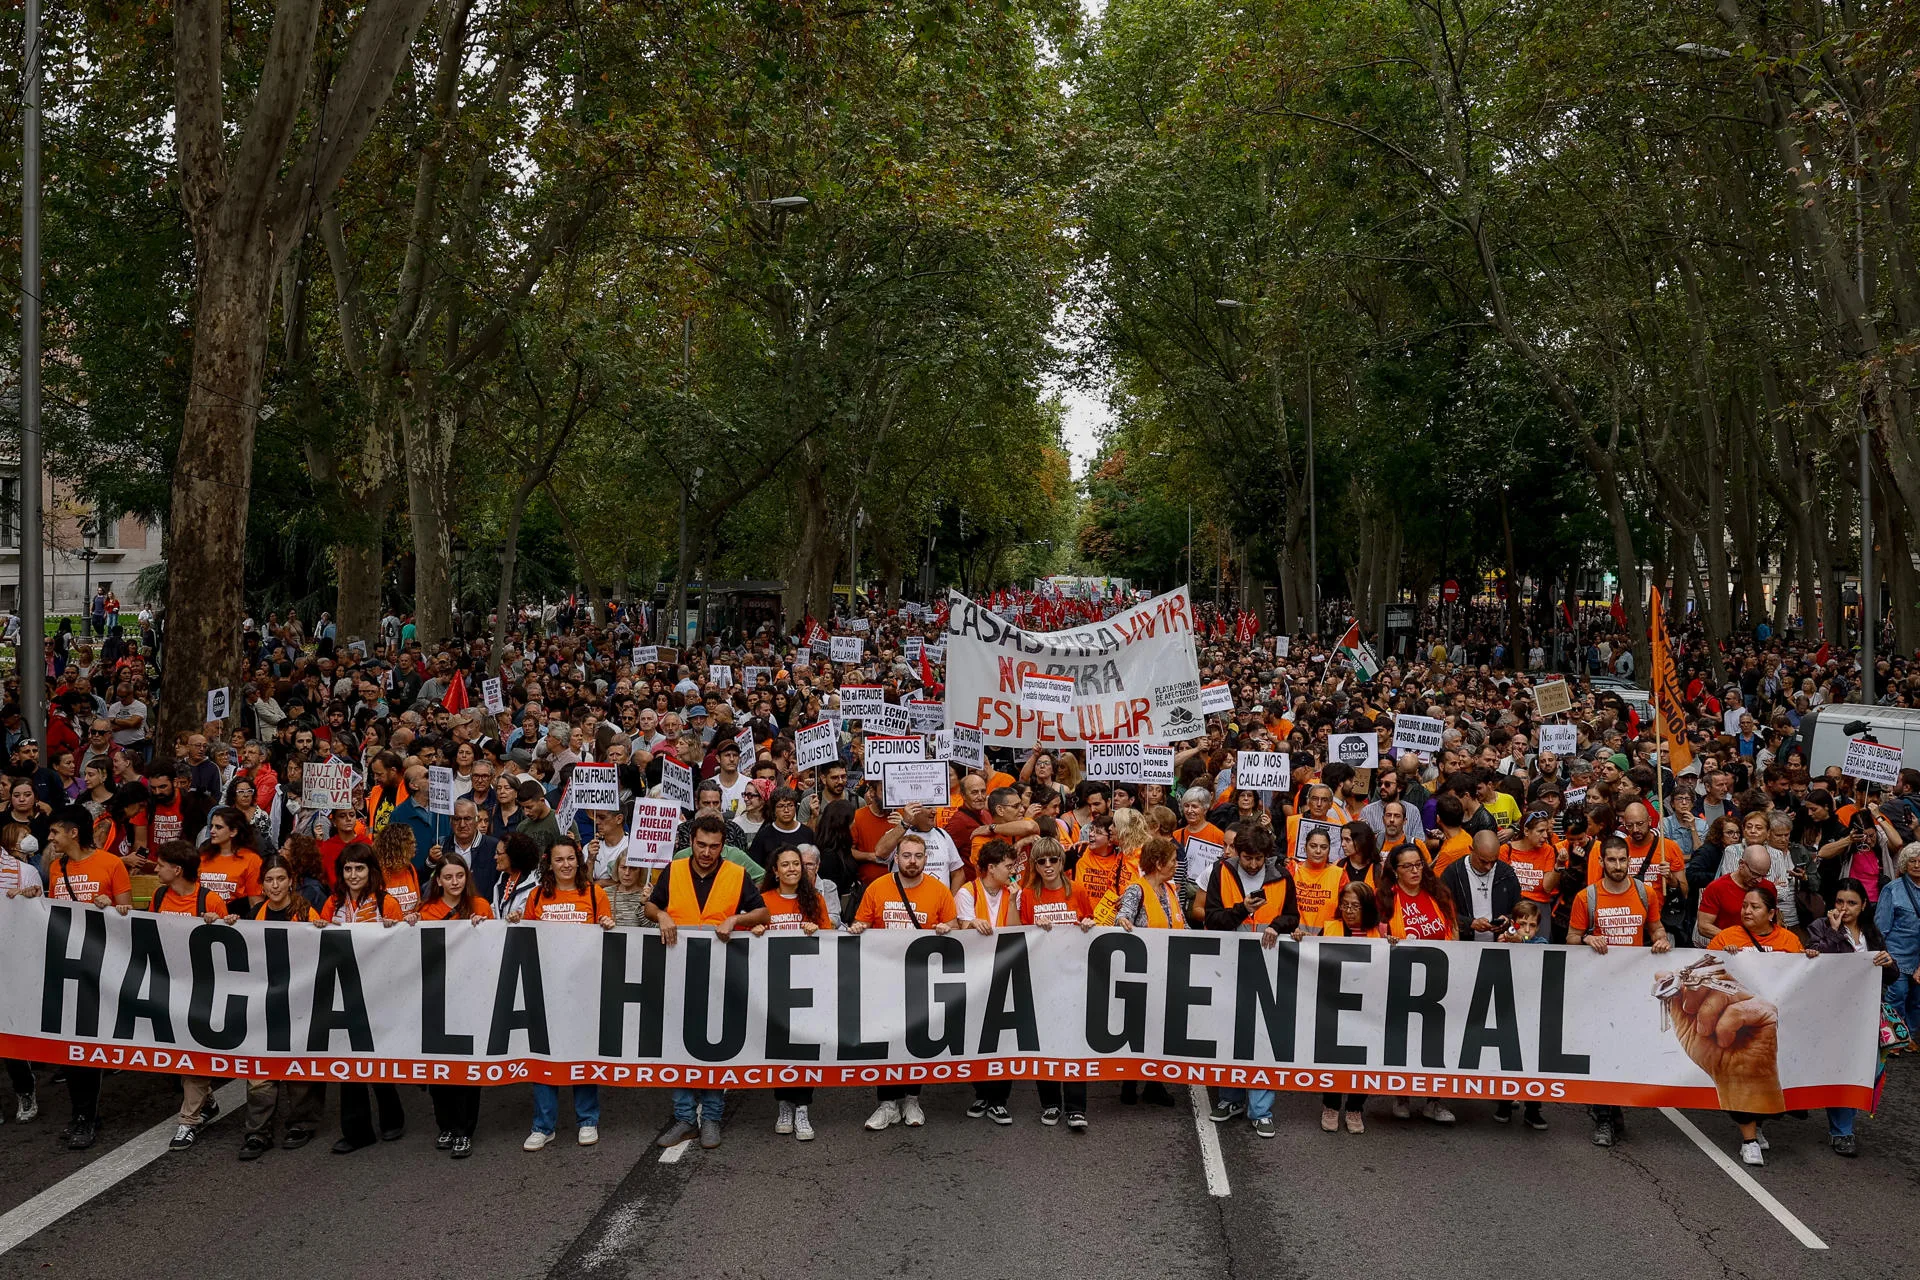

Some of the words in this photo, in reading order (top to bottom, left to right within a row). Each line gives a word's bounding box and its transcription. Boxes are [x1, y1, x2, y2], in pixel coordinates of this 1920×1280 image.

[949, 598, 1044, 653] CASAS
[1045, 627, 1119, 657] PARA
[845, 639, 856, 648] NOS
[998, 656, 1038, 694] NO
[1045, 659, 1125, 696] PARA
[1155, 680, 1198, 694] PLATAFORMA
[1164, 687, 1198, 700] AFECTADOS
[841, 689, 851, 700] NO
[852, 690, 858, 700] al
[859, 689, 882, 700] FRAUDE
[842, 704, 882, 716] HIPOTECARIO!
[884, 707, 908, 720] ECHO
[977, 697, 1153, 742] ESPECULAR
[1397, 719, 1421, 731] SUELDOS,
[1163, 724, 1204, 738] ALCORCÓN
[1340, 742, 1366, 751] STOP
[1395, 733, 1417, 745] PISOS,
[1417, 735, 1440, 747] ABAJO!
[798, 751, 807, 766] LO
[807, 743, 834, 764] JUSTO!
[868, 740, 920, 757] ¡PEDIMOS
[1089, 744, 1140, 760] ¡PEDIMOS
[1849, 742, 1867, 755] PISOS:
[1868, 747, 1877, 757] SU
[1243, 754, 1260, 769] ¡NO
[1263, 754, 1282, 769] NOS
[1340, 752, 1368, 760] DESAHUCIOS
[305, 764, 331, 777] AQUI
[335, 764, 351, 778] NO
[866, 761, 880, 774] LO
[1088, 763, 1102, 775] LO
[1105, 762, 1142, 775] JUSTO!
[1866, 759, 1877, 771] QUE
[575, 769, 584, 783] NO
[591, 769, 616, 783] FRAUDE
[664, 762, 670, 775] NO
[674, 767, 691, 785] FRAUDE
[1238, 771, 1288, 788] CALLARÁN!
[304, 777, 317, 788] HAY
[318, 778, 350, 790] QUIEN
[330, 791, 351, 803] VA
[575, 789, 616, 804] HIPOTECARIO!
[1565, 788, 1587, 798] ENDEN
[639, 805, 657, 817] POR
[659, 807, 677, 818] UNA
[640, 818, 672, 829] HUELGA
[636, 830, 672, 842] GENERAL
[647, 842, 657, 853] YA
[542, 904, 576, 912] SINDICATO
[1034, 903, 1067, 912] SINDICATO
[1597, 907, 1631, 916] SINDICATO
[550, 912, 586, 920] INQUILINAS
[770, 913, 803, 922] SINDICATO
[1599, 918, 1607, 926] DE
[1607, 916, 1642, 926] INQUILINAS
[1420, 918, 1445, 937] BACK
[1605, 927, 1638, 935] INQUILINOS
[1609, 936, 1633, 944] MADRID
[41, 905, 376, 1053] HACIA
[421, 926, 551, 1056] LA
[598, 931, 1041, 1062] HUELGA
[1085, 932, 1592, 1074] GENERAL
[68, 1044, 195, 1070] BAJADA
[210, 1056, 270, 1076] DEL
[285, 1060, 451, 1080] ALQUILER
[466, 1062, 529, 1081] 50%
[570, 1064, 823, 1084] EXPROPIACIÓN
[840, 1063, 972, 1082] FONDOS
[987, 1060, 1100, 1077] BUITRE
[1140, 1061, 1334, 1088] CONTRATOS
[1351, 1073, 1566, 1098] INDEFINIDOS
